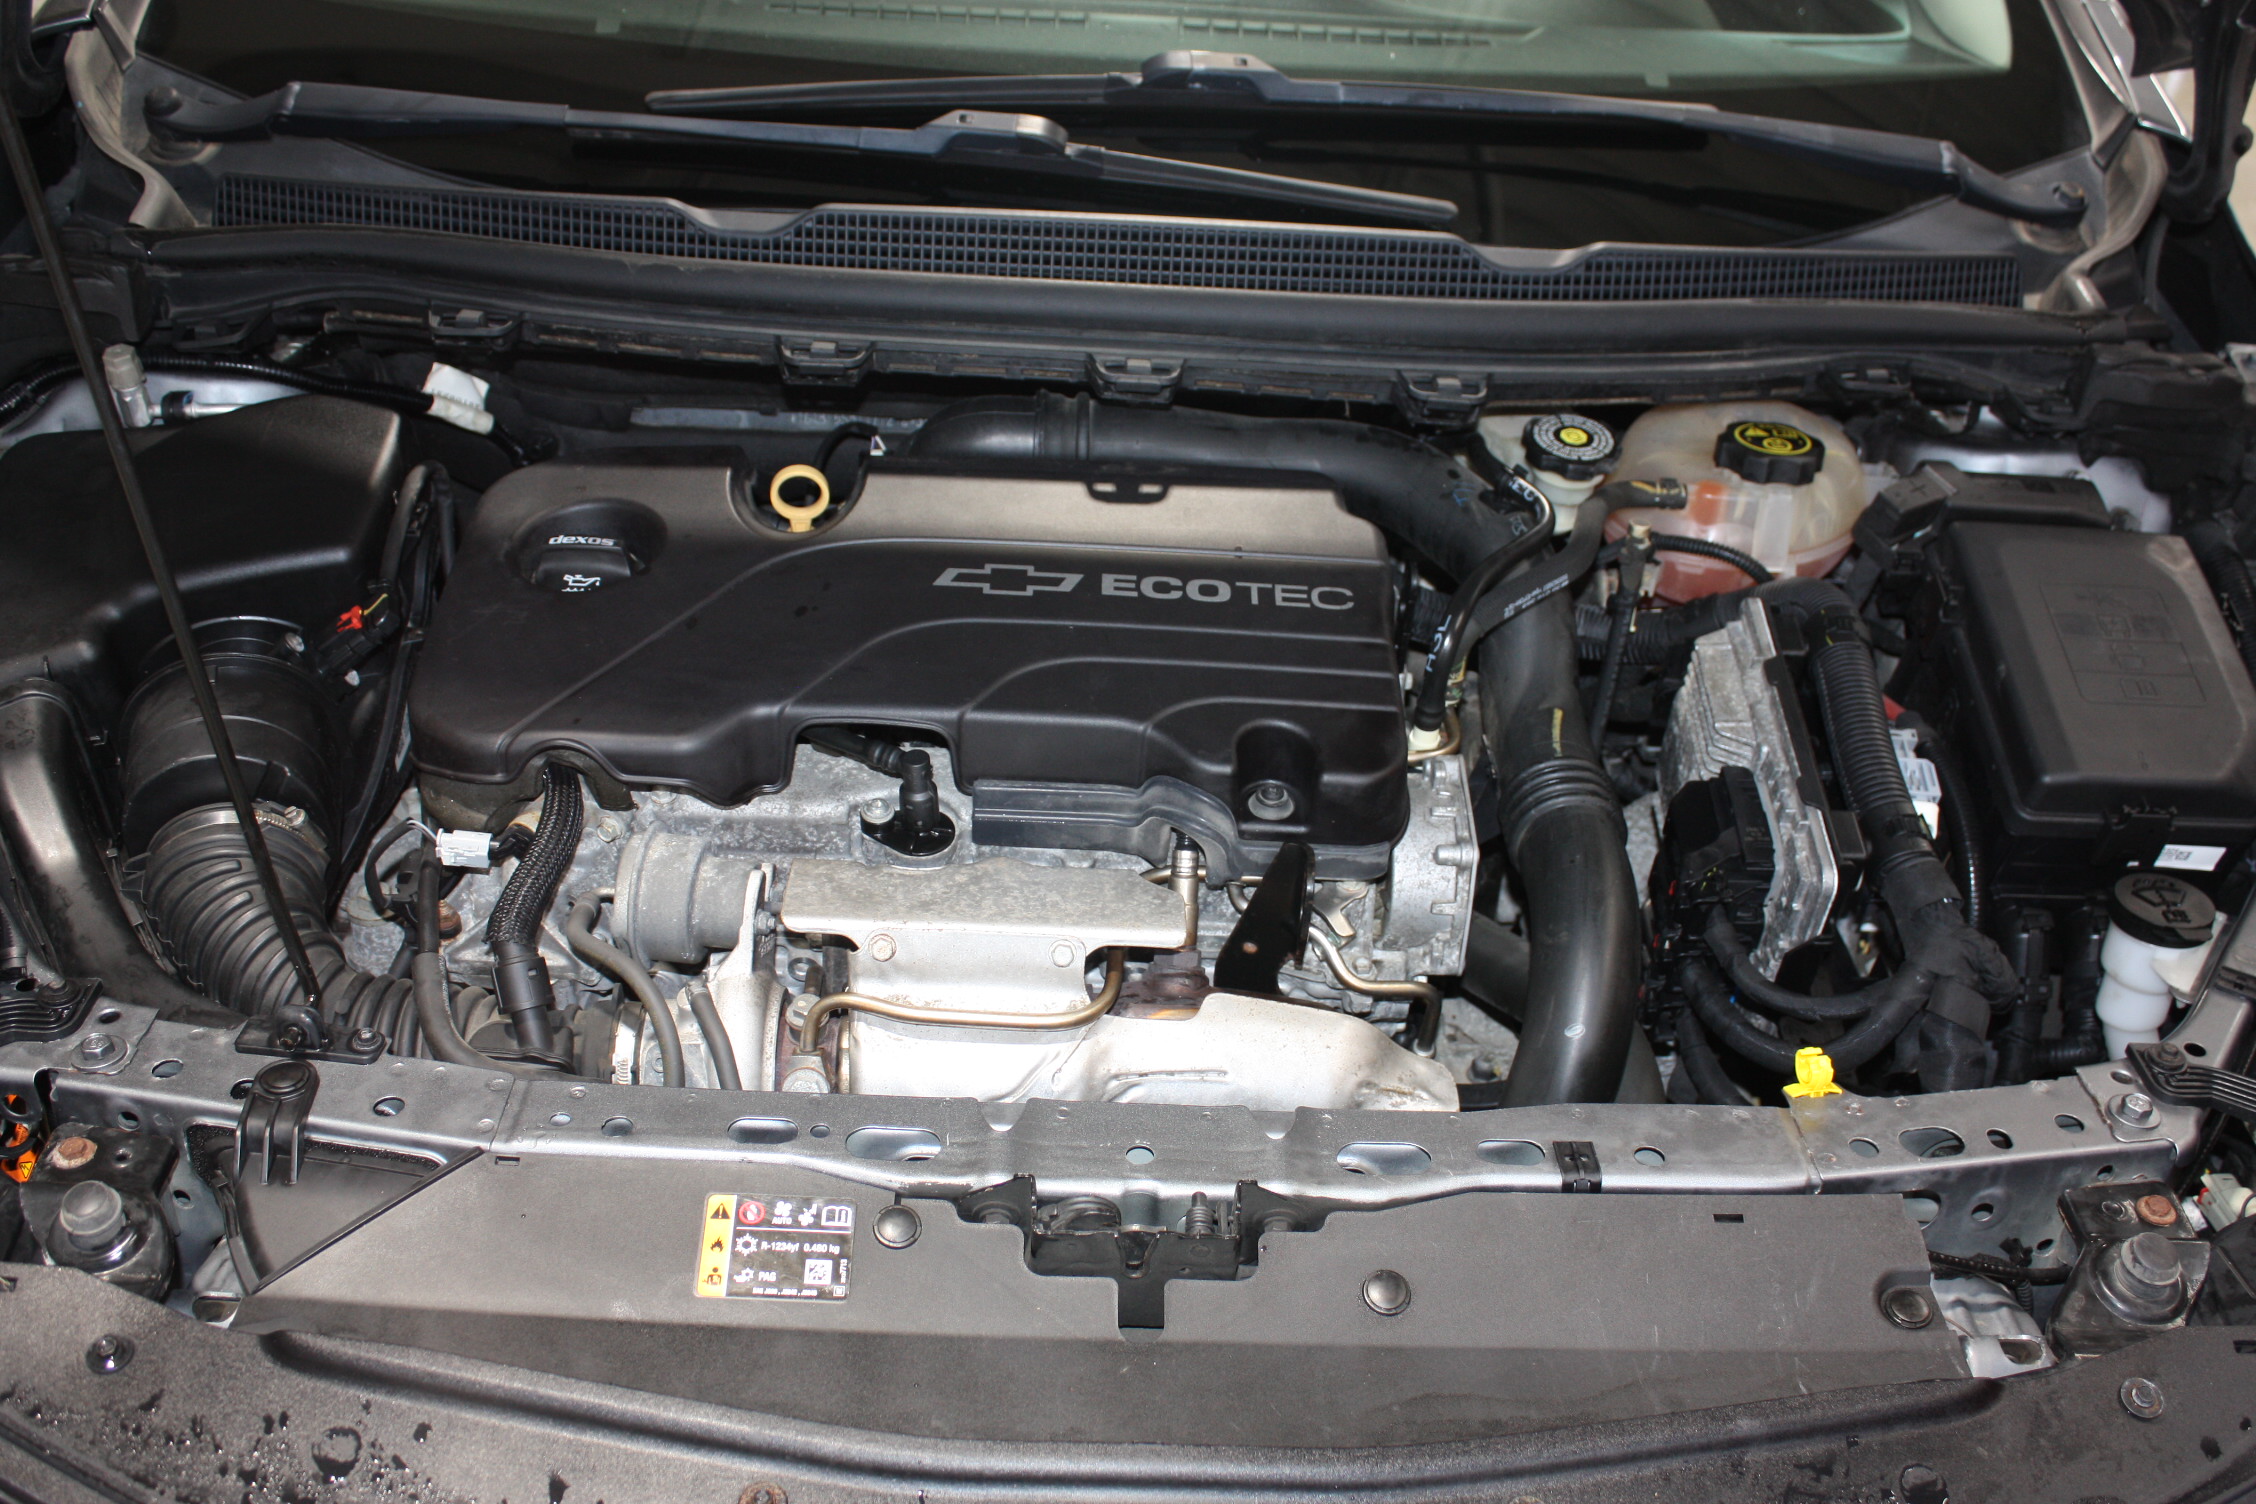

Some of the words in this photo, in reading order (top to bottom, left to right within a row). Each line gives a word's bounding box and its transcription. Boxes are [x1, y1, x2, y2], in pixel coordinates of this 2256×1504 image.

[548, 534, 616, 547] dexos
[1101, 573, 1355, 611] ECOTEC
[772, 1217, 793, 1225] AUTO
[829, 1244, 840, 1255] kg
